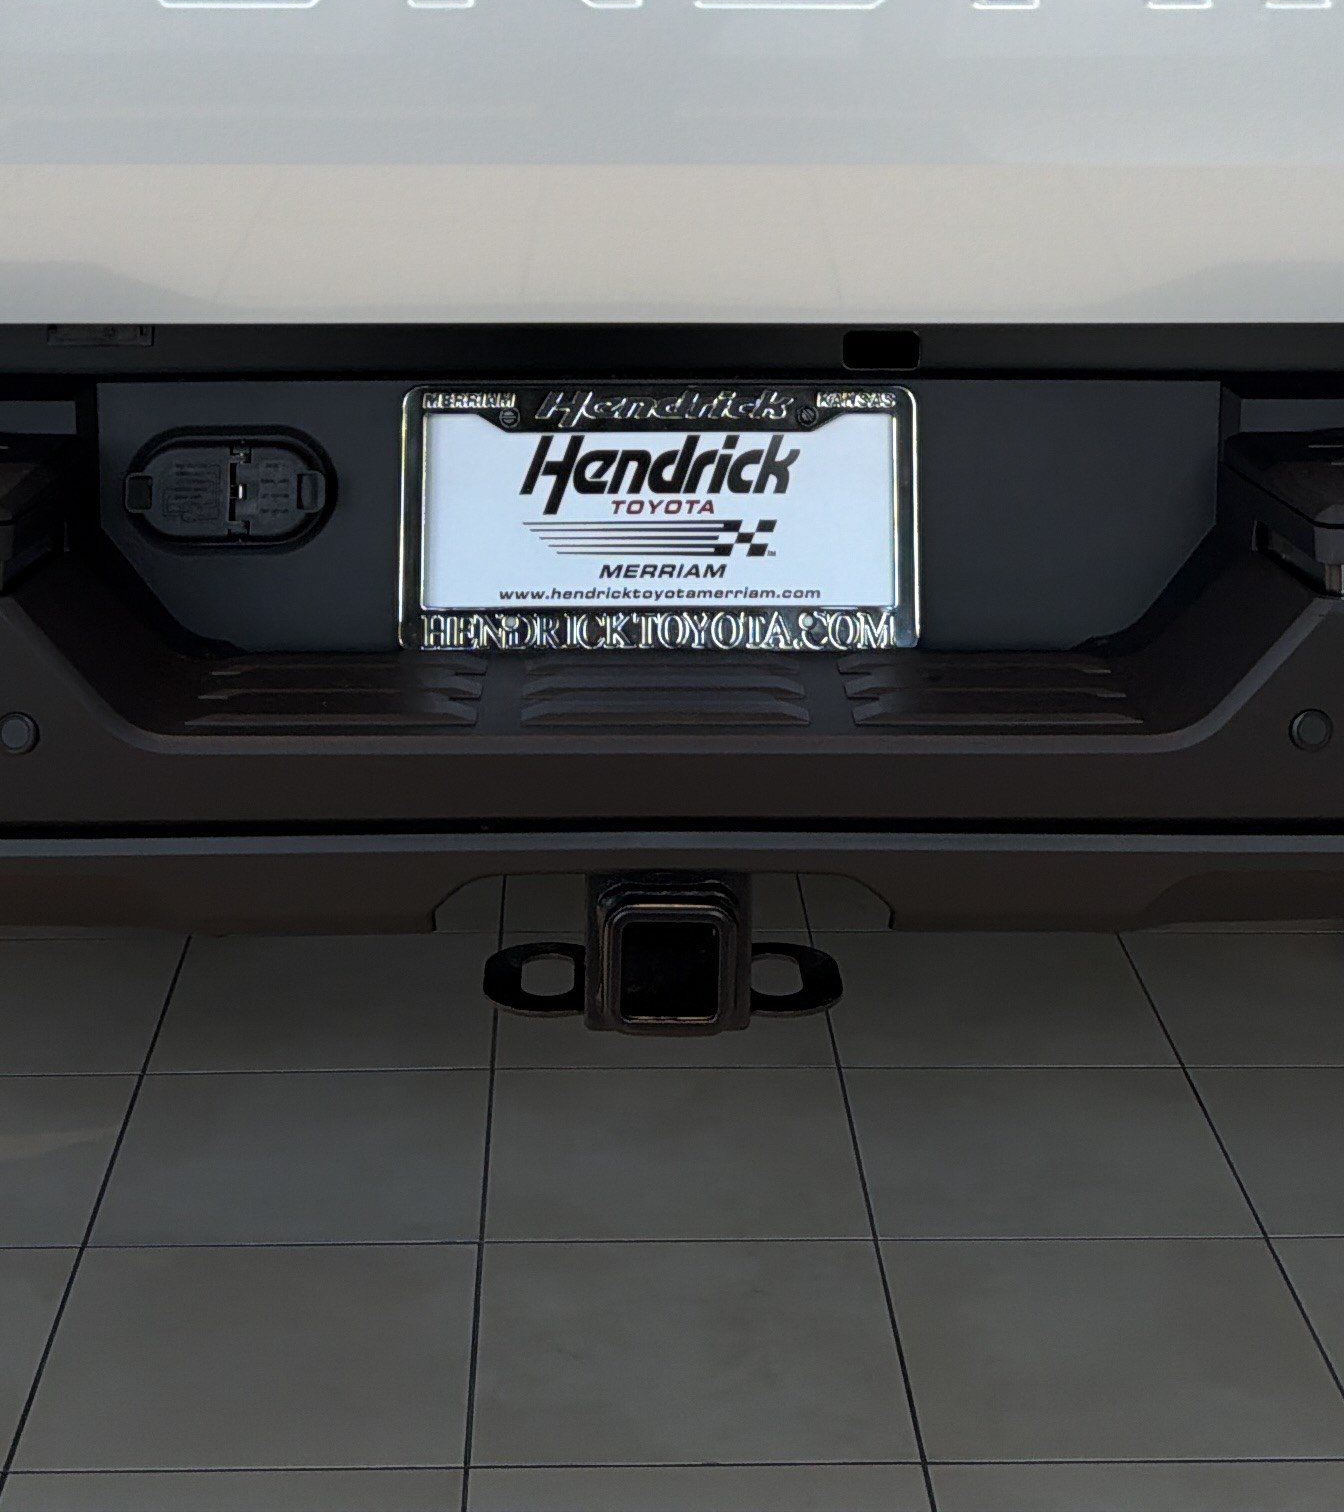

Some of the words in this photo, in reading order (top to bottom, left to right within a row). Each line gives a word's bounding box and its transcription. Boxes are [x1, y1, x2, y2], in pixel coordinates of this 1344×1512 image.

[422, 392, 517, 409] MERRIAM
[534, 390, 795, 429] Hendrick
[816, 391, 897, 408] KANSAS
[519, 434, 801, 515] Hendrick
[611, 499, 715, 514] TOYOTA
[599, 564, 727, 579] MERRIAM
[499, 586, 821, 601] www.hendricktoyotamerriam.com
[420, 610, 896, 651] HENDRICKTOYOTA.COM
